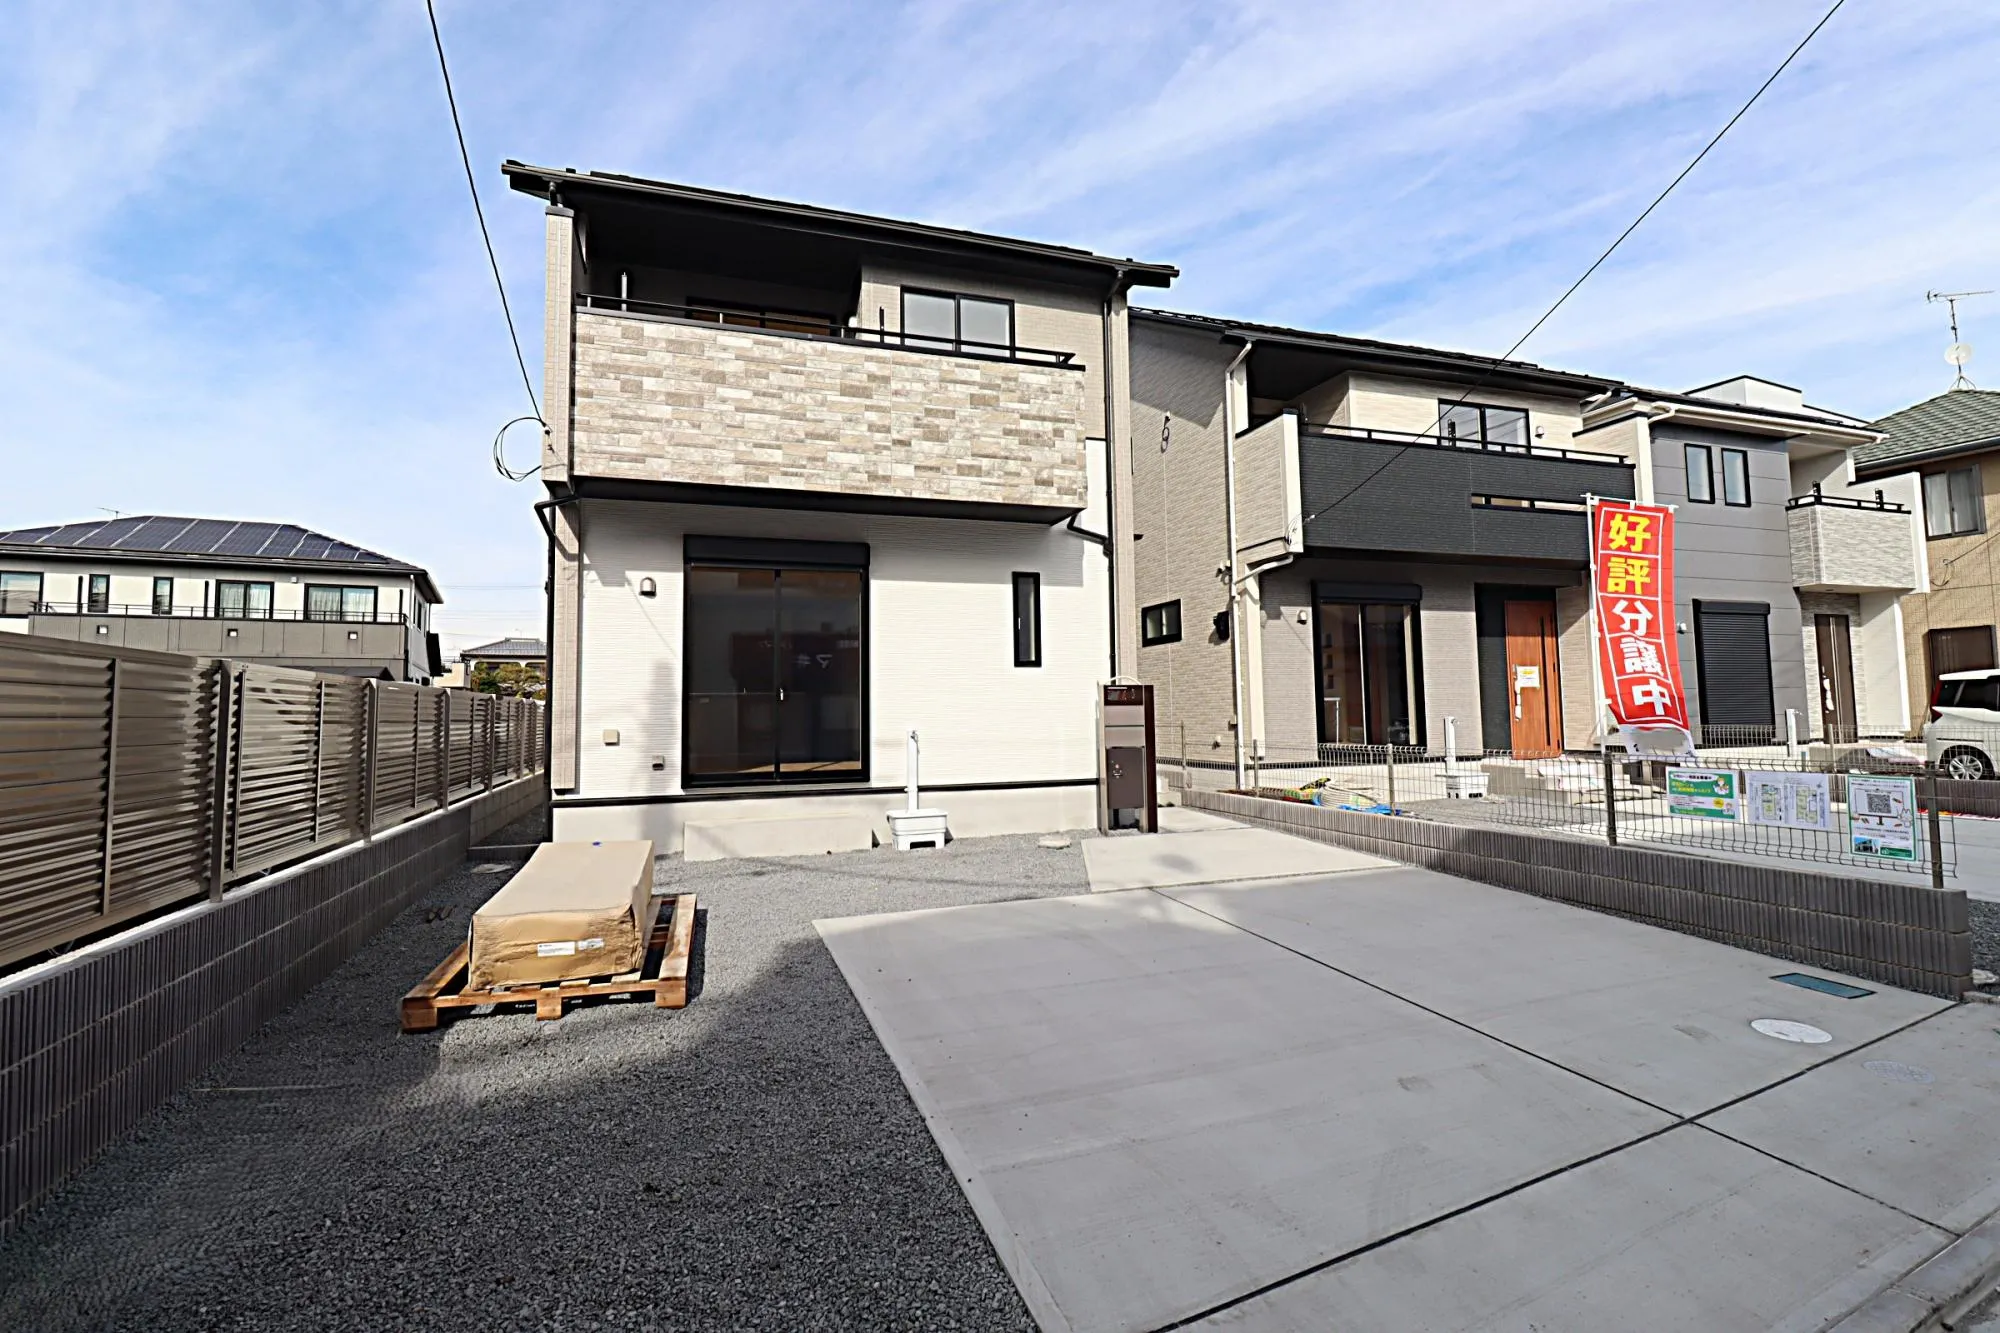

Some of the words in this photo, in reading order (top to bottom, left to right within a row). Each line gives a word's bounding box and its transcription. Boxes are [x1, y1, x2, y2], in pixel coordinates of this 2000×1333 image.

[1607, 513, 1672, 716] 好評分譲中
